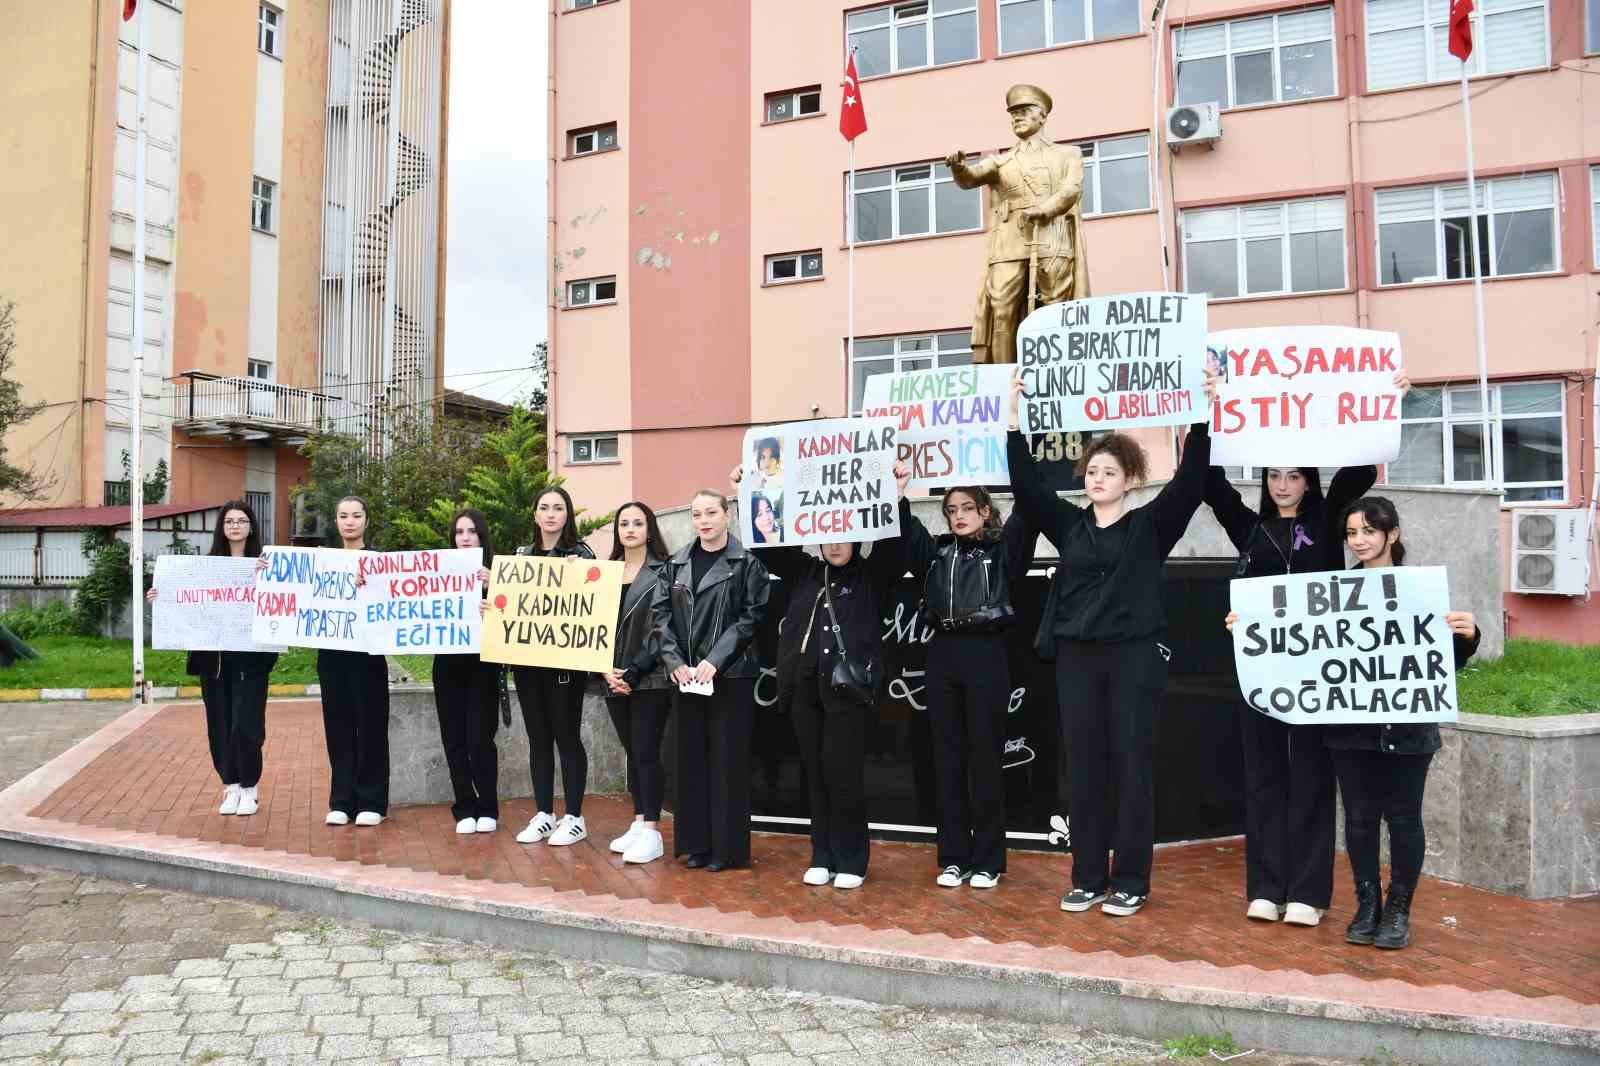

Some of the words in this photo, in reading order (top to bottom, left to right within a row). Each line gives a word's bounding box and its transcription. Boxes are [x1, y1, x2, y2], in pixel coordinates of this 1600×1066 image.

[1061, 301, 1089, 329] İÇİN
[1105, 296, 1188, 325] ADALET
[1068, 328, 1161, 360] BIRAKTIM
[1229, 345, 1397, 380] YAŞAMAK
[932, 396, 1000, 426] KALAN
[1027, 400, 1063, 432] BEN
[1338, 392, 1397, 425] RUZ
[797, 427, 896, 460] KADINLAR
[822, 458, 862, 486] HER
[798, 479, 881, 507] ZAMAN
[359, 552, 439, 575] KADINLARI
[496, 561, 564, 588] KADIN
[390, 573, 475, 598] KORUYUN
[1306, 575, 1369, 616] BİZ
[367, 596, 464, 623] ERKEKLERİ
[517, 593, 595, 617] KADININ
[503, 620, 608, 650] YUVASIDIR
[1243, 613, 1435, 656] SUSARSAK
[1321, 650, 1448, 685] ONLAR
